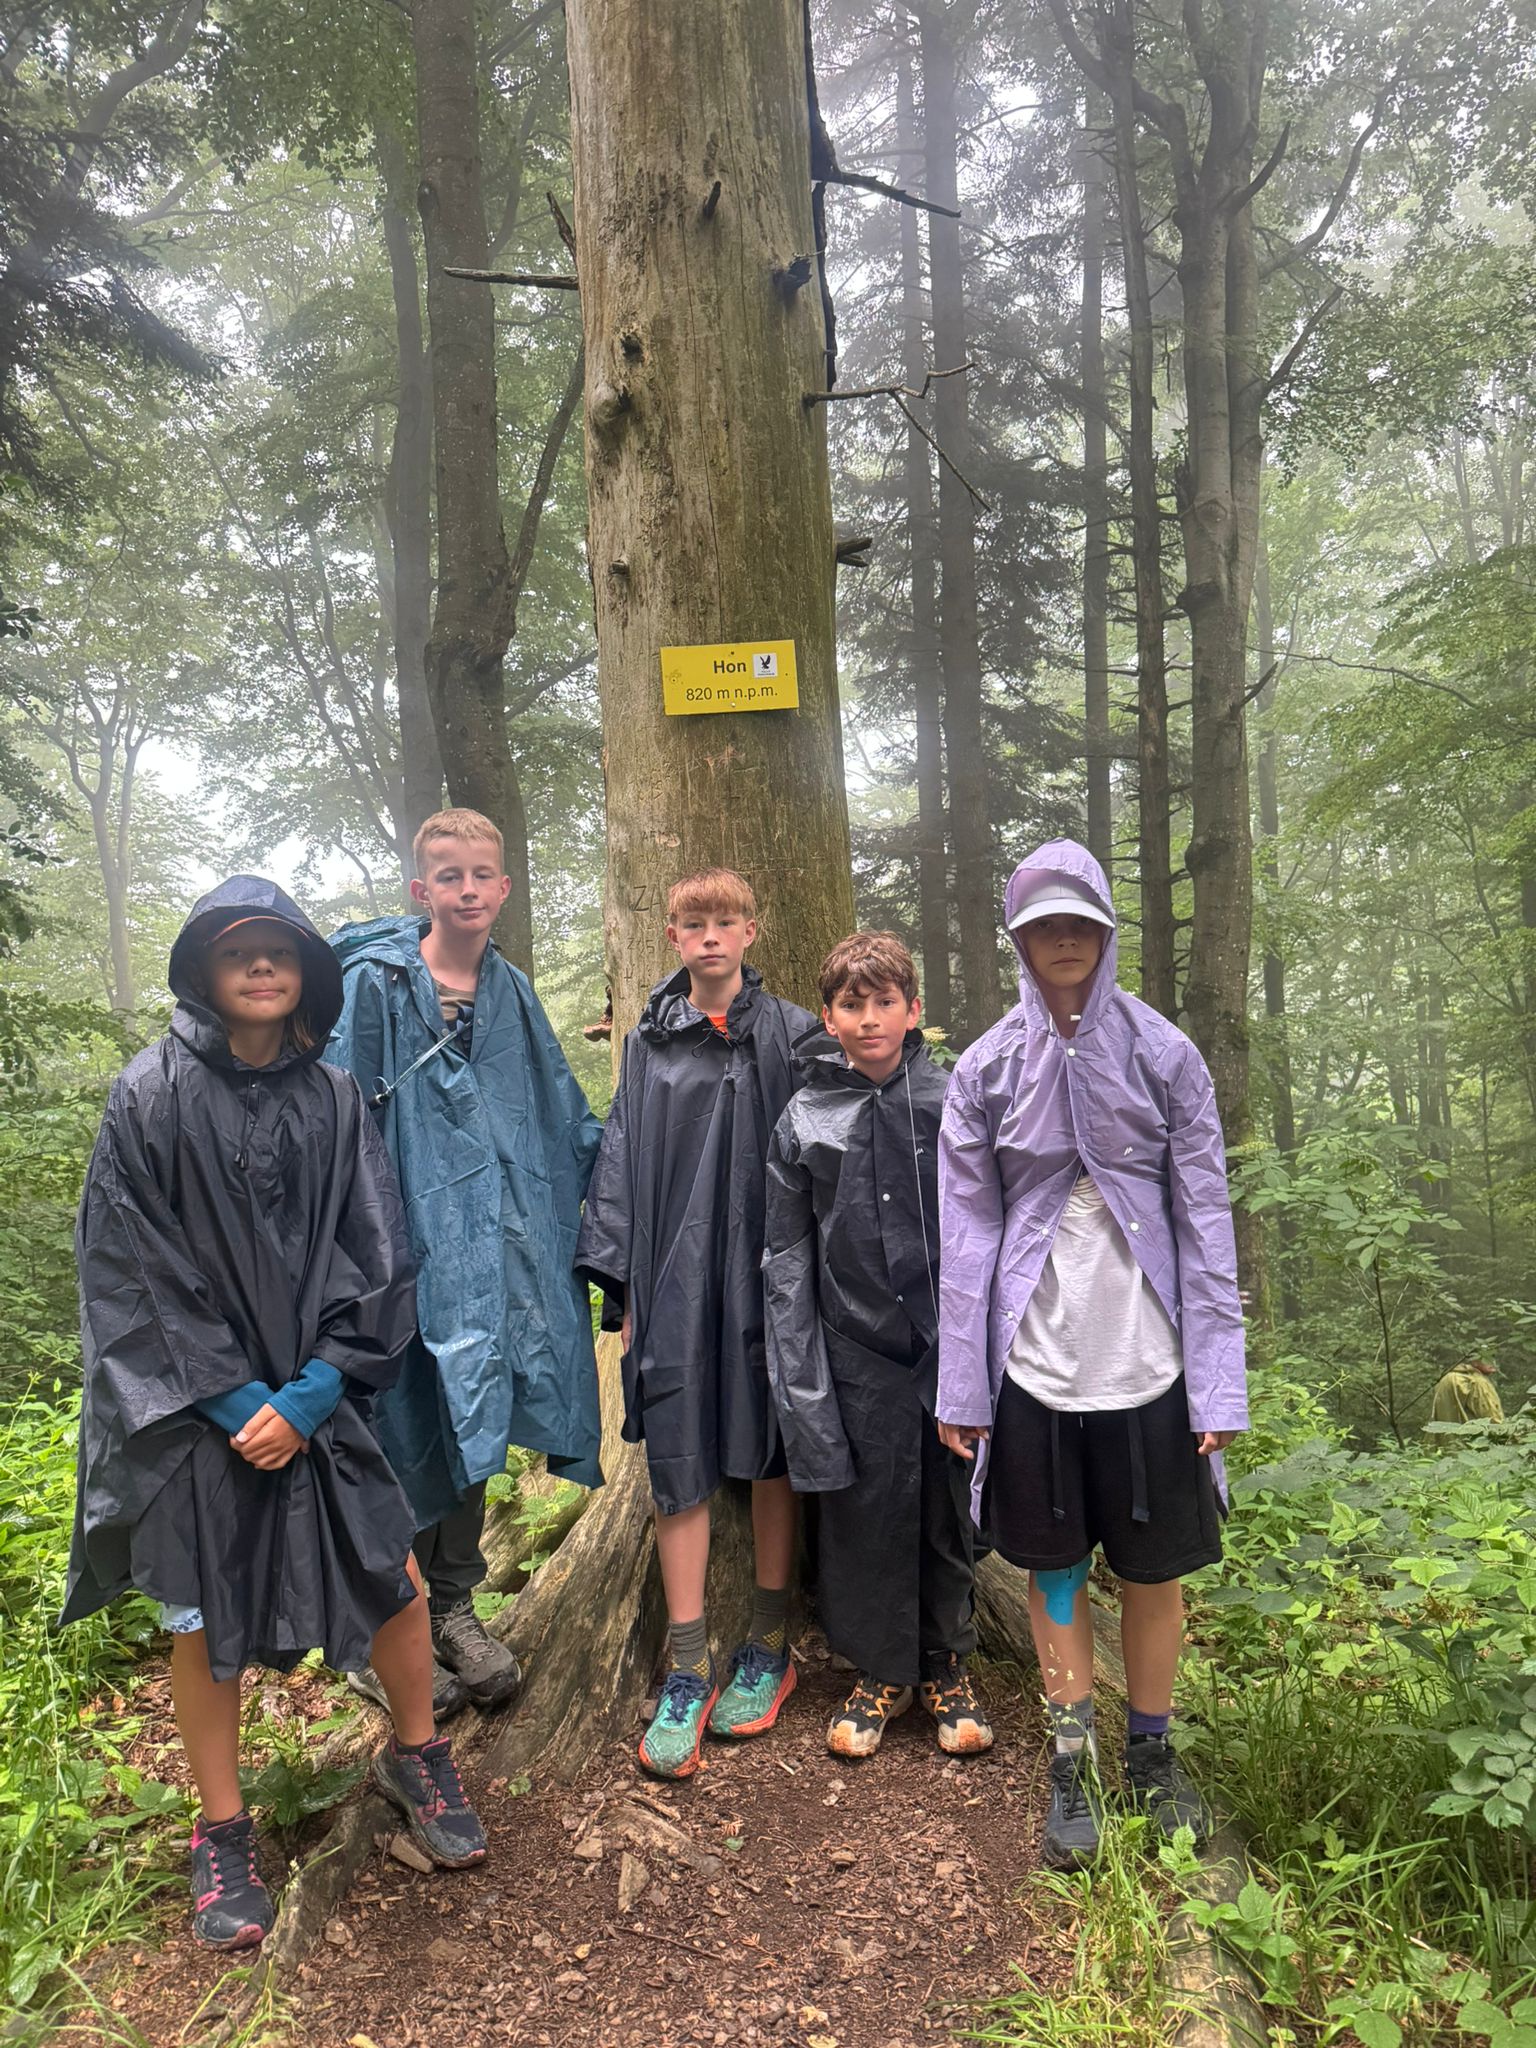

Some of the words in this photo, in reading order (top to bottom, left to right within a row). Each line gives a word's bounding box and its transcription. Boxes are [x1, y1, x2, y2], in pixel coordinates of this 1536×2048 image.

[713, 660, 747, 674] Hon
[686, 687, 712, 701] 820
[717, 688, 730, 700] m
[734, 686, 778, 700] n.p.m.
